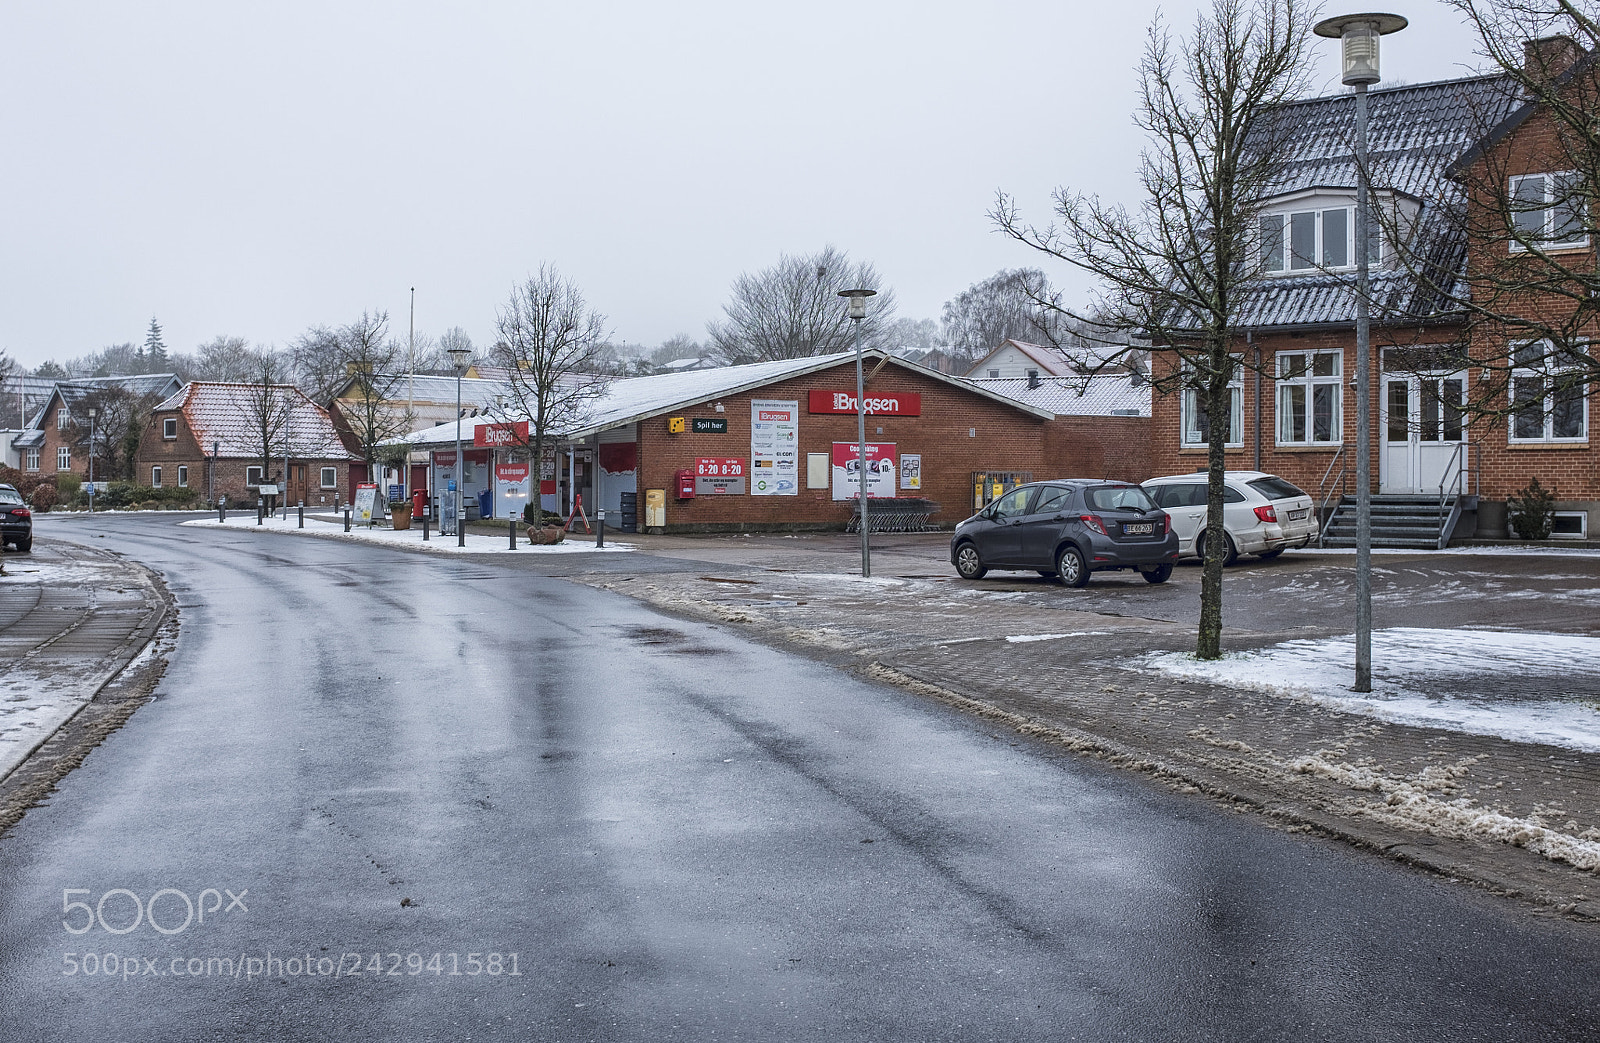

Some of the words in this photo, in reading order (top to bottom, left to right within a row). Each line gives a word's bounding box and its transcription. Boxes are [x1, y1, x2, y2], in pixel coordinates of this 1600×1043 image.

[839, 393, 899, 415] Brugsen
[697, 421, 710, 430] Spil
[711, 421, 723, 429] her
[698, 464, 718, 475] 8-20
[722, 464, 741, 475] 8-20
